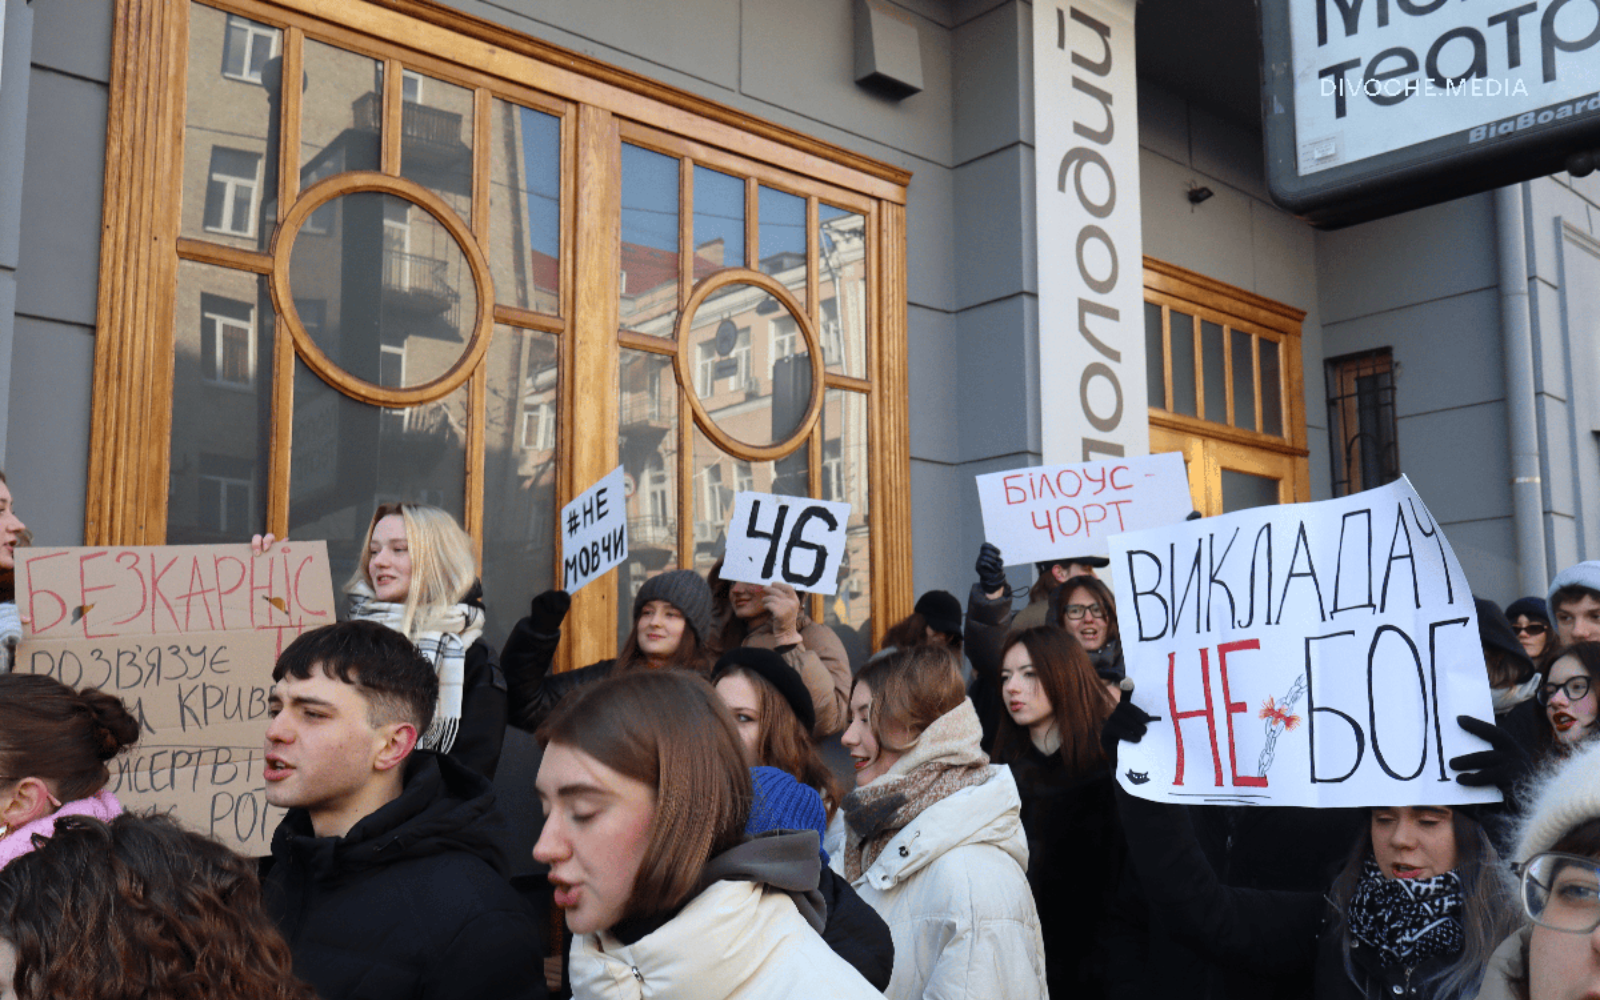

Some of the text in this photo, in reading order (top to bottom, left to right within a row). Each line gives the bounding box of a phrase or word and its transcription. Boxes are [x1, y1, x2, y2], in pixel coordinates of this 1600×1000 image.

[1318, 0, 1600, 119] театр
[564, 524, 624, 589] МОВЧИ
[567, 487, 609, 538] #НЕ
[746, 500, 838, 587] 46
[1031, 500, 1132, 543] ЧОРТ
[1126, 497, 1454, 642] ВИКЛАДАЧ
[1167, 639, 1268, 787] НЕ
[1305, 617, 1470, 784] БОГ
